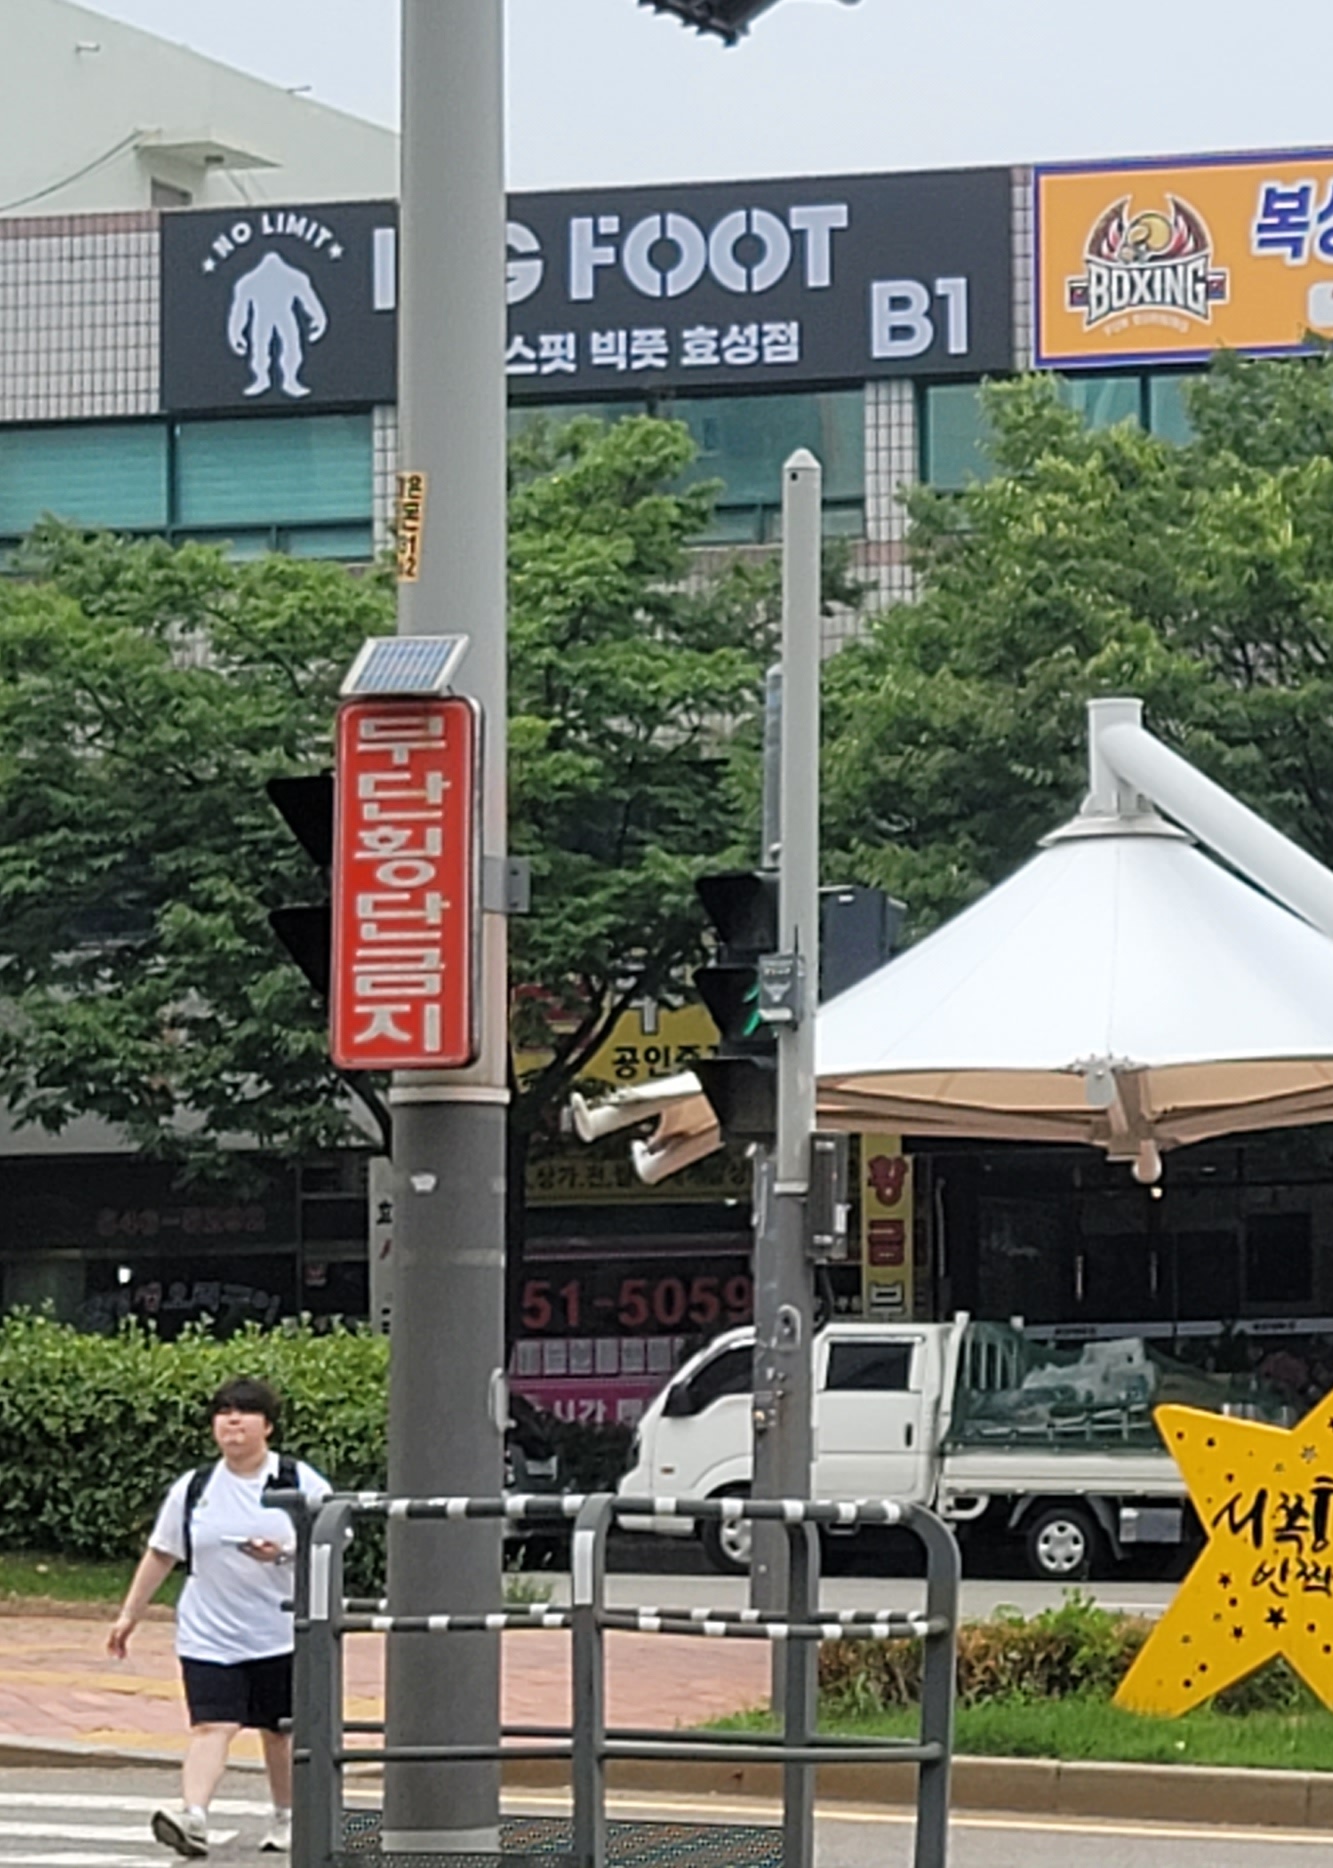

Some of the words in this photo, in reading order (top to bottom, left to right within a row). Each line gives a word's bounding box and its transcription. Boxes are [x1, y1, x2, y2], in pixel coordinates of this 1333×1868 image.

[212, 221, 252, 258] NO
[261, 212, 333, 249] LIMIT
[569, 204, 848, 301] FOOT
[871, 278, 969, 358] B1
[1088, 257, 1207, 322] BOXING
[505, 332, 577, 375] 스핏
[680, 321, 799, 366] 효성점
[353, 715, 451, 1054] 무단횡단금지
